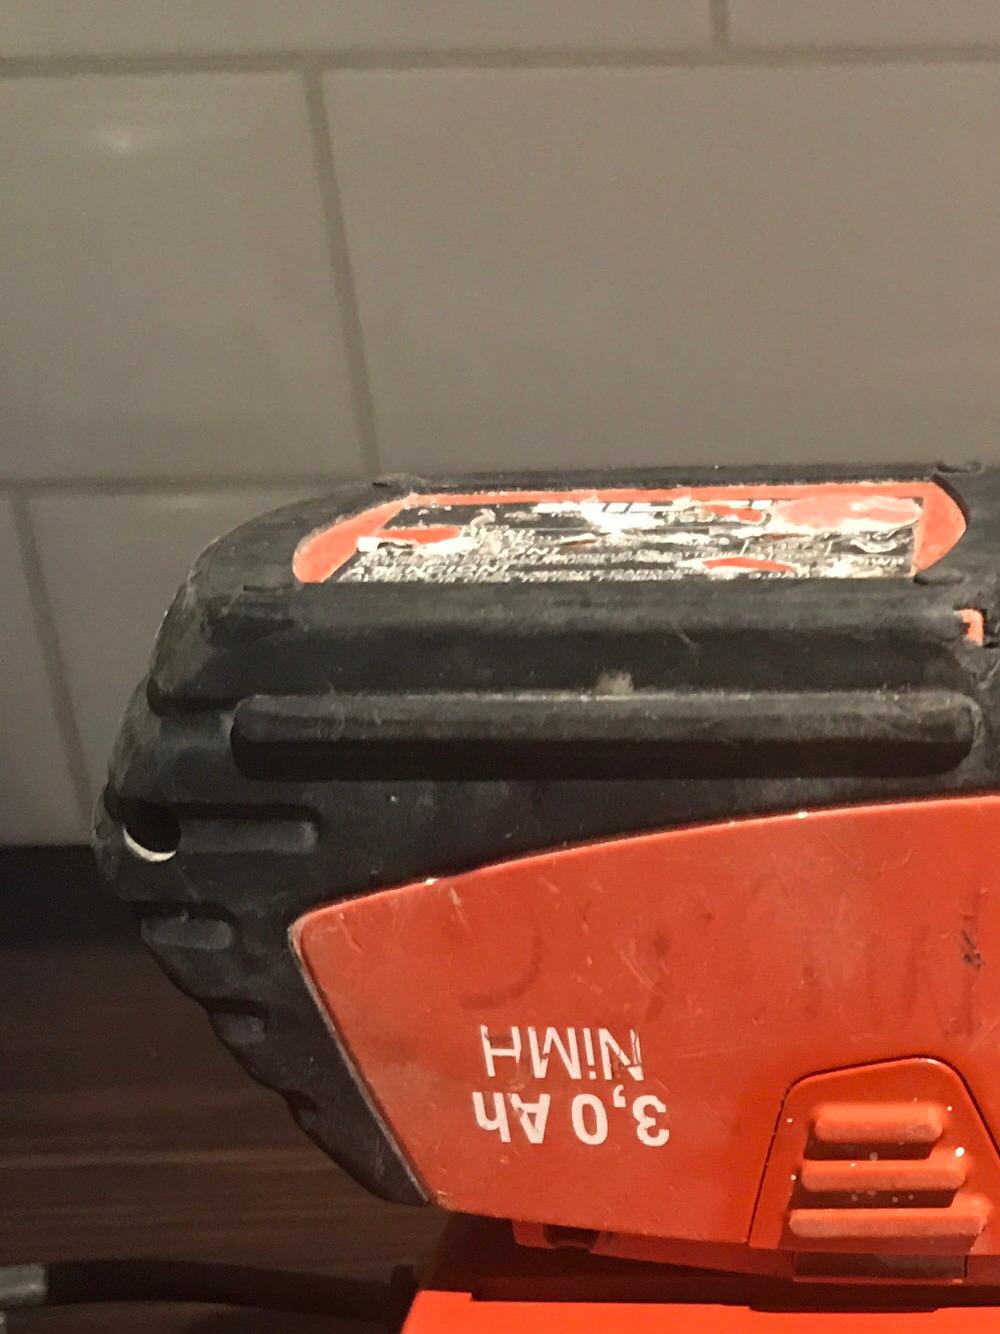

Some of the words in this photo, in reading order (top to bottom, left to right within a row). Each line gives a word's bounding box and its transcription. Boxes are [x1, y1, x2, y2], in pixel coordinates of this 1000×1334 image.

[479, 1024, 644, 1082] NiMH
[471, 1091, 551, 1144] Ah
[571, 1084, 670, 1147] 3,0
